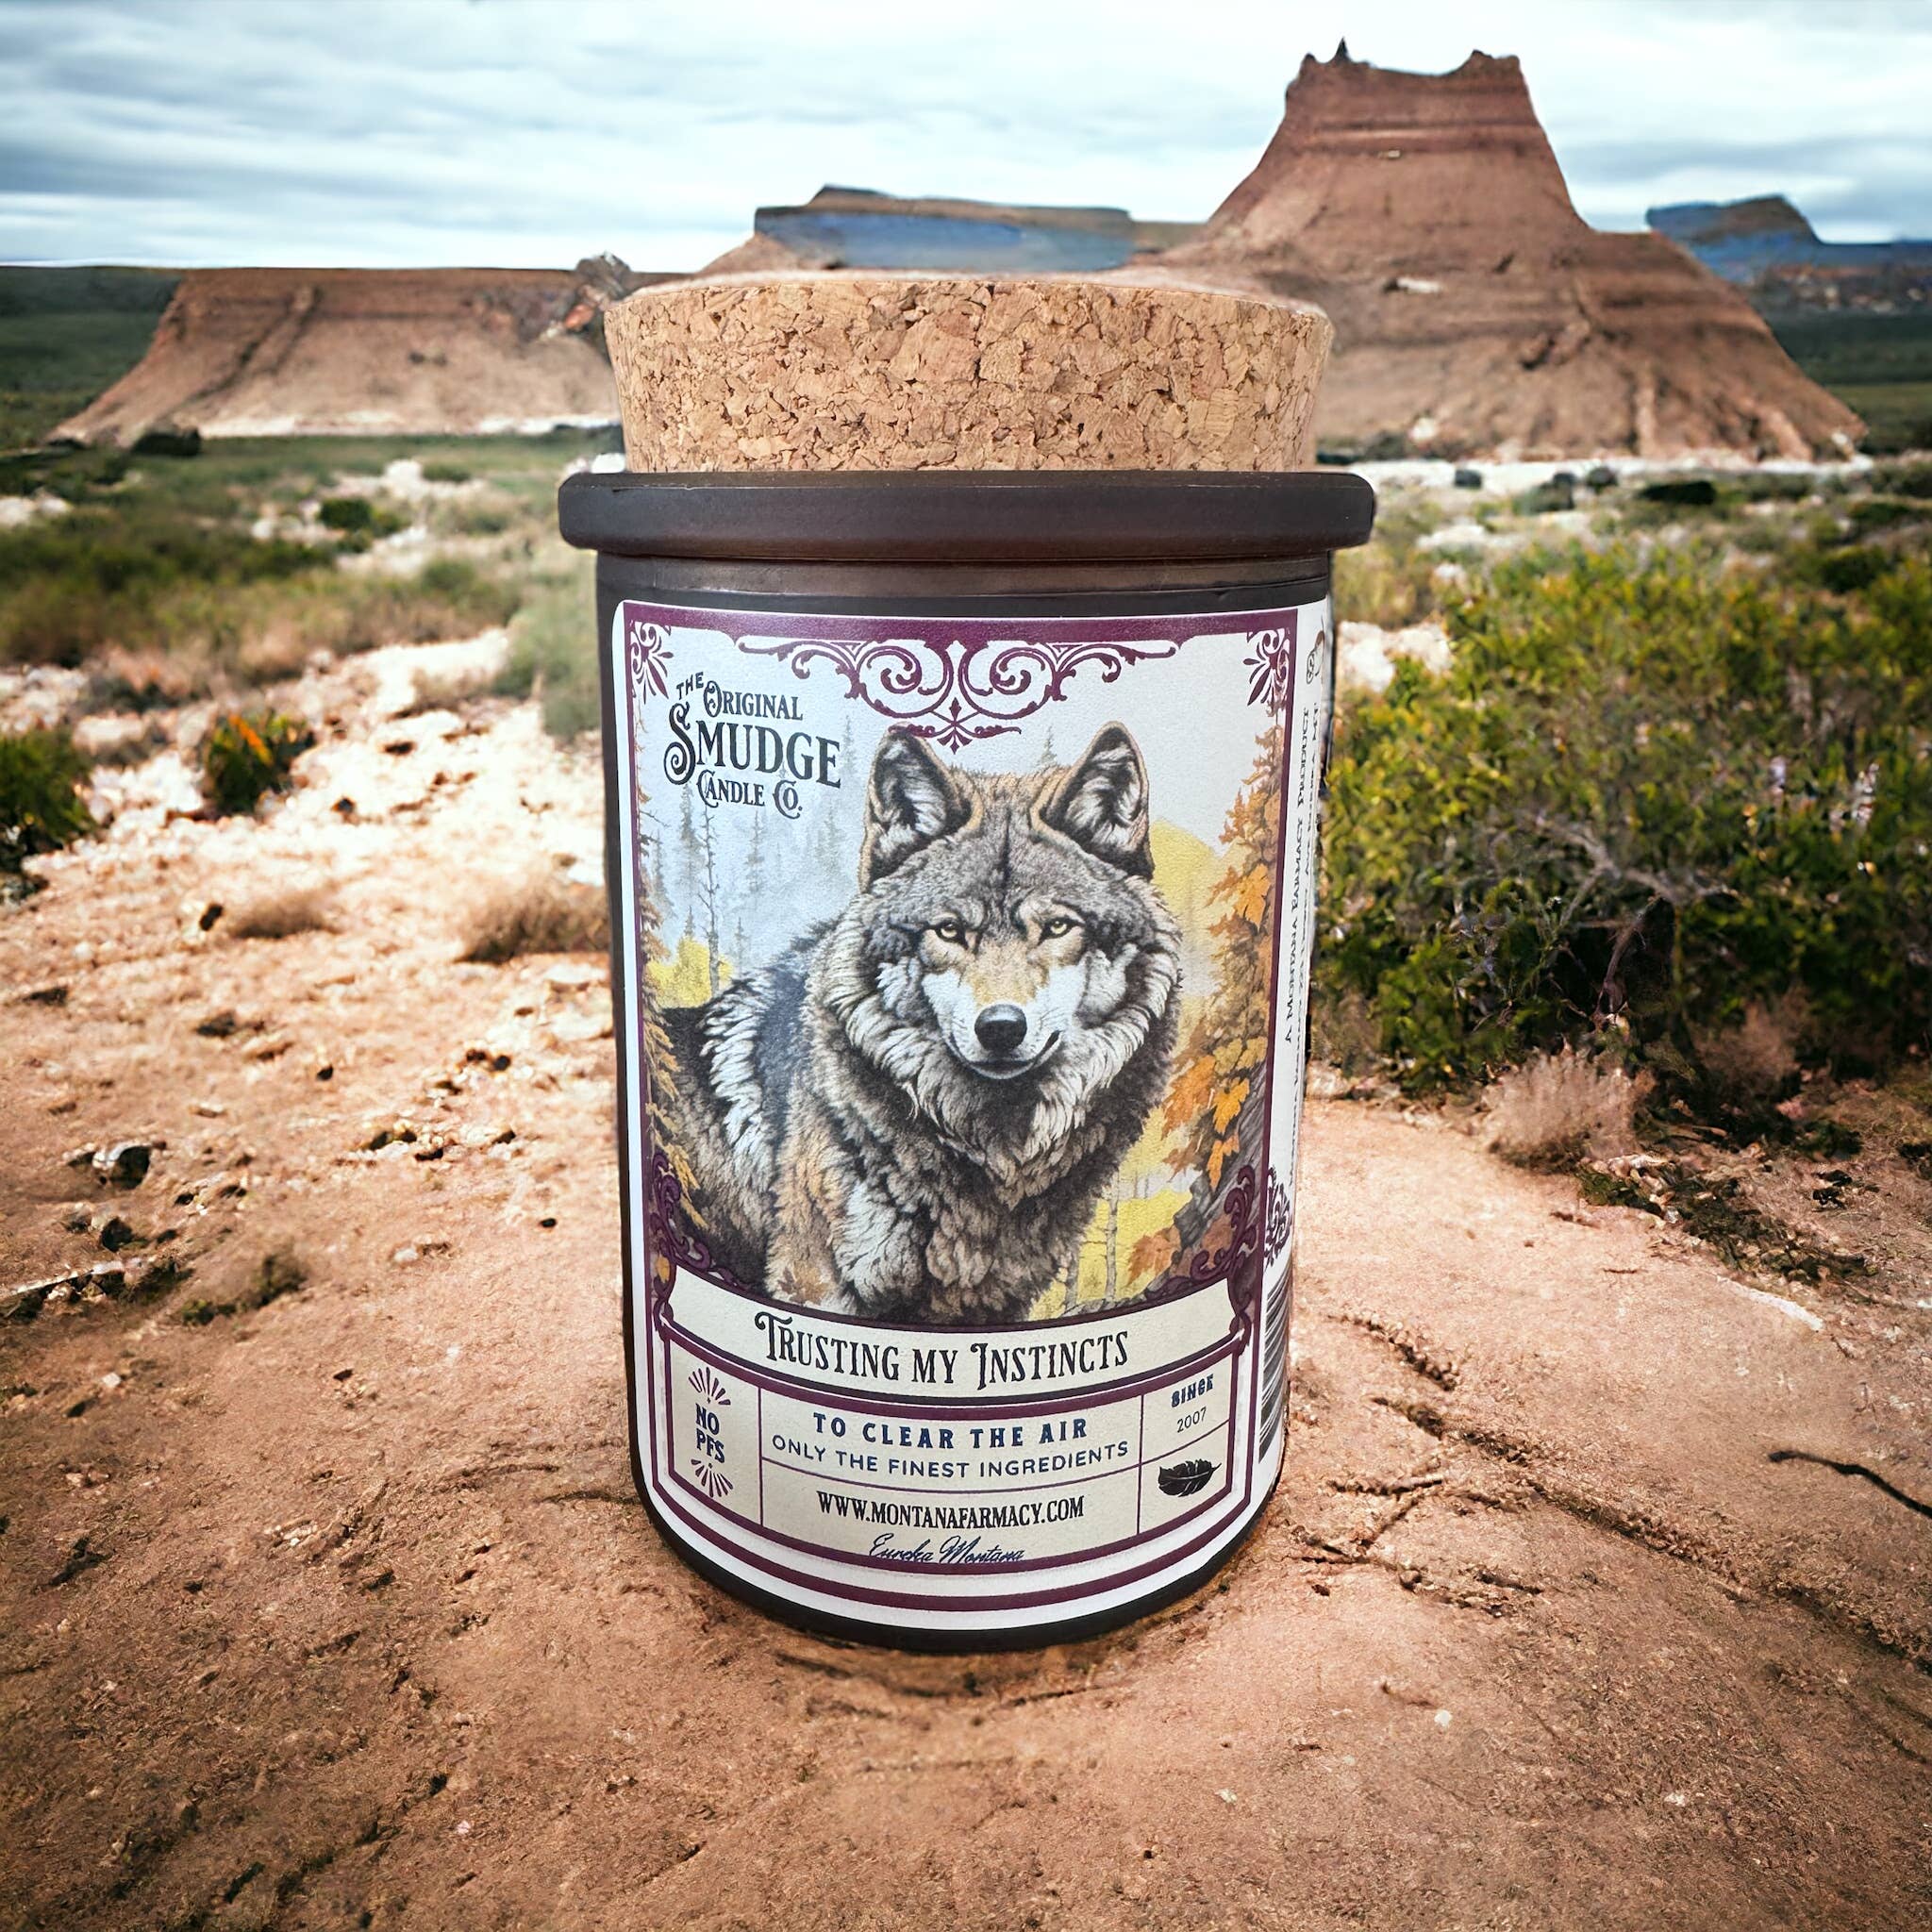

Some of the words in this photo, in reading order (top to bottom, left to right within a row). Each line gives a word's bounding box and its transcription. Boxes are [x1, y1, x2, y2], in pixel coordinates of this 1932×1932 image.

[675, 671, 705, 700] THE
[703, 679, 804, 721] ORIGINAL
[663, 701, 841, 789] SMUDGE
[696, 769, 765, 808] CANDLE
[772, 779, 804, 820] CO.
[754, 1311, 899, 1381] TRUSTING
[911, 1348, 958, 1384] MY
[970, 1330, 1129, 1391] INSTINCTS
[1171, 1374, 1214, 1408] SINCE
[695, 1402, 720, 1435] NO
[813, 1412, 846, 1438] TO
[861, 1423, 954, 1449] CLEAR
[970, 1425, 1024, 1449] THE
[1039, 1418, 1088, 1444] AIR
[1176, 1406, 1207, 1433] 2007
[696, 1427, 725, 1463] PFS
[772, 1434, 826, 1462] ONLY
[836, 1450, 878, 1473] THE
[888, 1457, 970, 1478] FINEST
[979, 1441, 1129, 1478] INGREDIENTS
[816, 1490, 1085, 1530] WWW.MONTANAFARMACY.COM
[939, 1535, 1025, 1564] Montana
